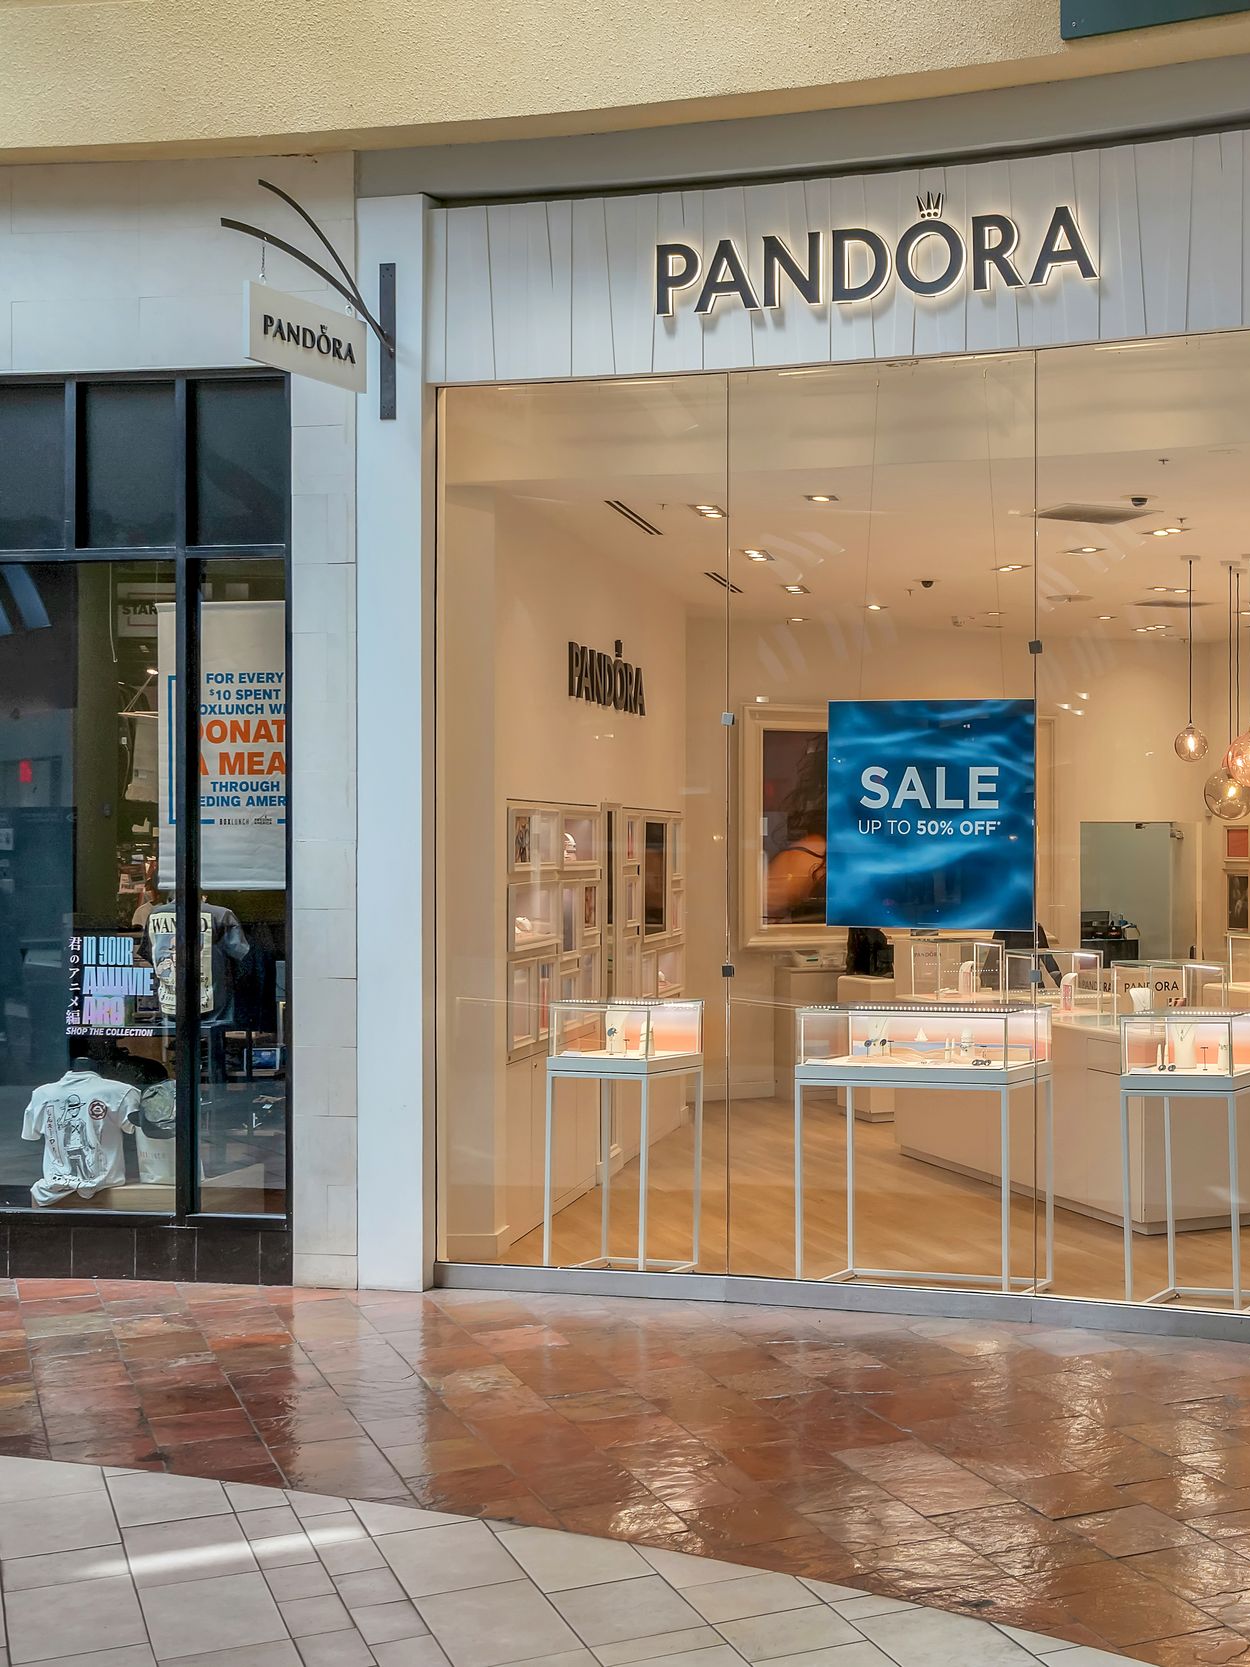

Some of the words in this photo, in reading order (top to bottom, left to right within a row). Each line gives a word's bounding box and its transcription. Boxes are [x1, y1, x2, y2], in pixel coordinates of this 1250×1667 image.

[656, 204, 1101, 317] PANDORA
[263, 314, 356, 364] PANDORA
[206, 672, 234, 684] FOR
[239, 672, 284, 684] EVERY
[568, 640, 645, 716] PANDORA
[209, 689, 231, 700] $10
[236, 689, 281, 700] SPENT
[200, 719, 286, 744] ONAT
[210, 781, 280, 793] THROUGH
[859, 766, 999, 809] SALE
[858, 820, 882, 835] UP
[887, 820, 911, 835] TO
[916, 820, 954, 836] 50%
[152, 917, 208, 933] WAND
[66, 1027, 87, 1035] SHOP
[90, 1028, 104, 1036] THE
[106, 1028, 153, 1037] COLLECTION
